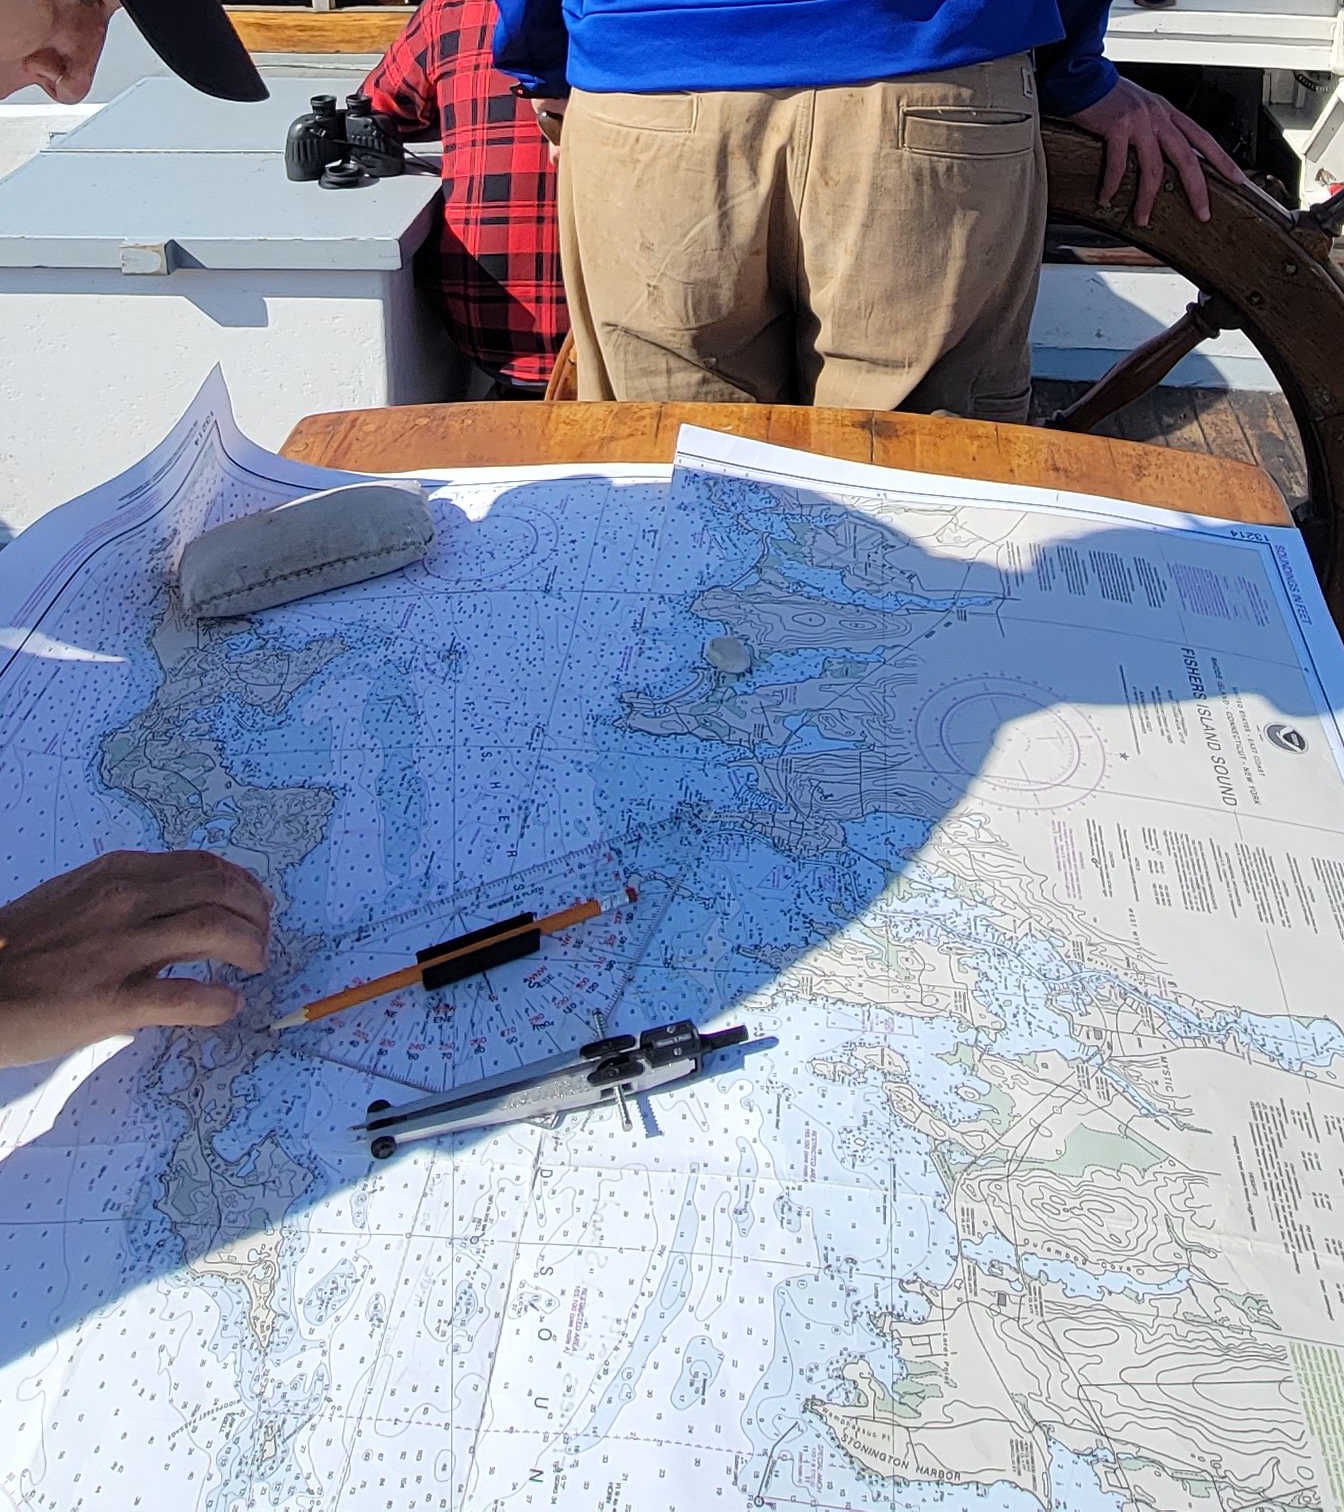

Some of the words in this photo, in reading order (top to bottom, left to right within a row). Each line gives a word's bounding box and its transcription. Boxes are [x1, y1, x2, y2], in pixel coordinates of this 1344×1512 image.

[1230, 530, 1269, 541] 13214
[1276, 545, 1301, 592] SOUNDINGS
[1293, 593, 1304, 602] IN
[1297, 603, 1312, 625] FEET
[1180, 648, 1206, 700] FISHERS
[1195, 704, 1222, 751] ISLAND
[1210, 755, 1238, 807] SOUND
[1224, 712, 1246, 760] CONNECTICUT
[1241, 767, 1253, 783] NEW
[1248, 785, 1262, 805] YORK
[1247, 738, 1257, 753] EAST
[1252, 755, 1266, 777] COAST
[1158, 1056, 1174, 1093] MYSTIC
[576, 1288, 588, 1331] RESTRICTED
[571, 1332, 581, 1352] AREA
[840, 1432, 910, 1471] STONINGTON
[916, 1467, 961, 1481] HARBOR
